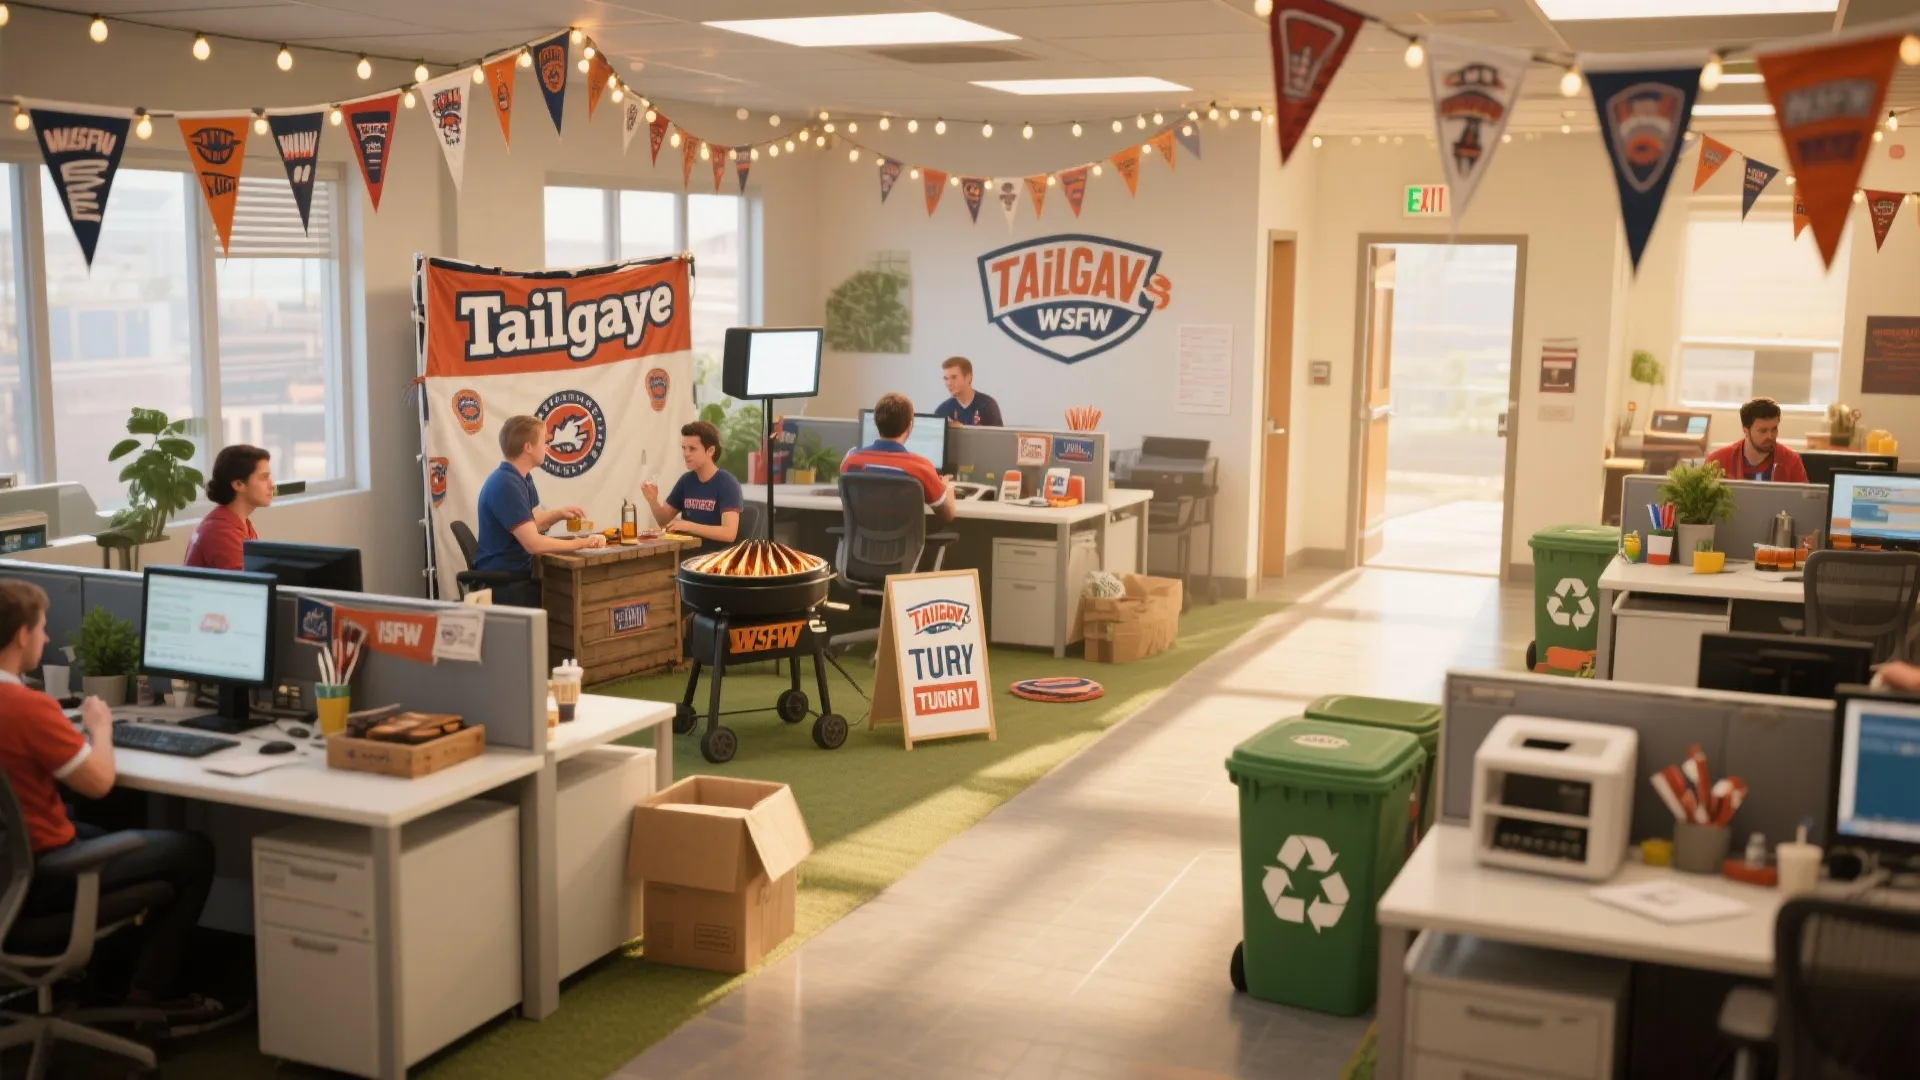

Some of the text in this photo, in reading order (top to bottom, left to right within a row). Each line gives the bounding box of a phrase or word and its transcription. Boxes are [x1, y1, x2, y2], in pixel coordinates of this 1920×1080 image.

[1407, 187, 1444, 212] EXIT
[457, 282, 673, 361] Tailgaye
[1037, 307, 1113, 332] WSFW
[729, 620, 807, 654] WSFW
[908, 643, 974, 680] TURY
